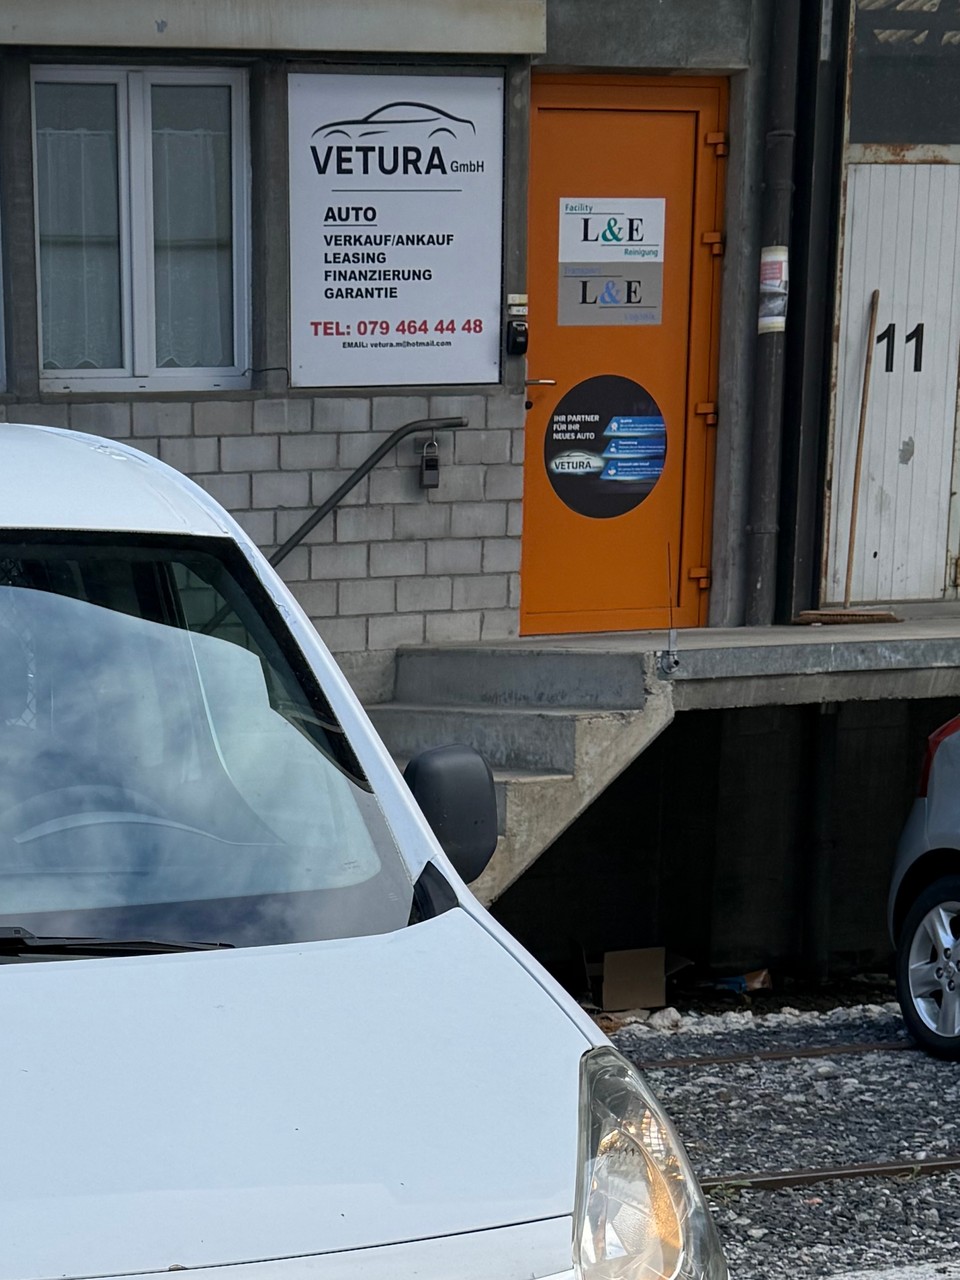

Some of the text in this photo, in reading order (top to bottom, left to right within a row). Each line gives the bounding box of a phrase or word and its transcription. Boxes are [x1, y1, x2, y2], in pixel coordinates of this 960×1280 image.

[310, 145, 485, 175] VETURA GmbH
[323, 206, 377, 222] AUTO
[565, 203, 593, 213] Facility
[581, 217, 644, 242] L&E
[323, 234, 455, 247] VERKAUF/ANKAUF
[324, 252, 387, 265] LEASING
[624, 248, 658, 257] Reinigung
[324, 269, 433, 282] FINANZIERUNG
[324, 287, 398, 299] GARANTIE
[579, 280, 642, 305] L&E
[310, 318, 483, 336] TEL: 079 464 44 48
[876, 323, 925, 373] 11
[567, 414, 600, 422] PARTNER
[553, 423, 567, 431] FÜR
[553, 432, 595, 440] NEUES AUTO
[554, 460, 592, 470] VETURA
